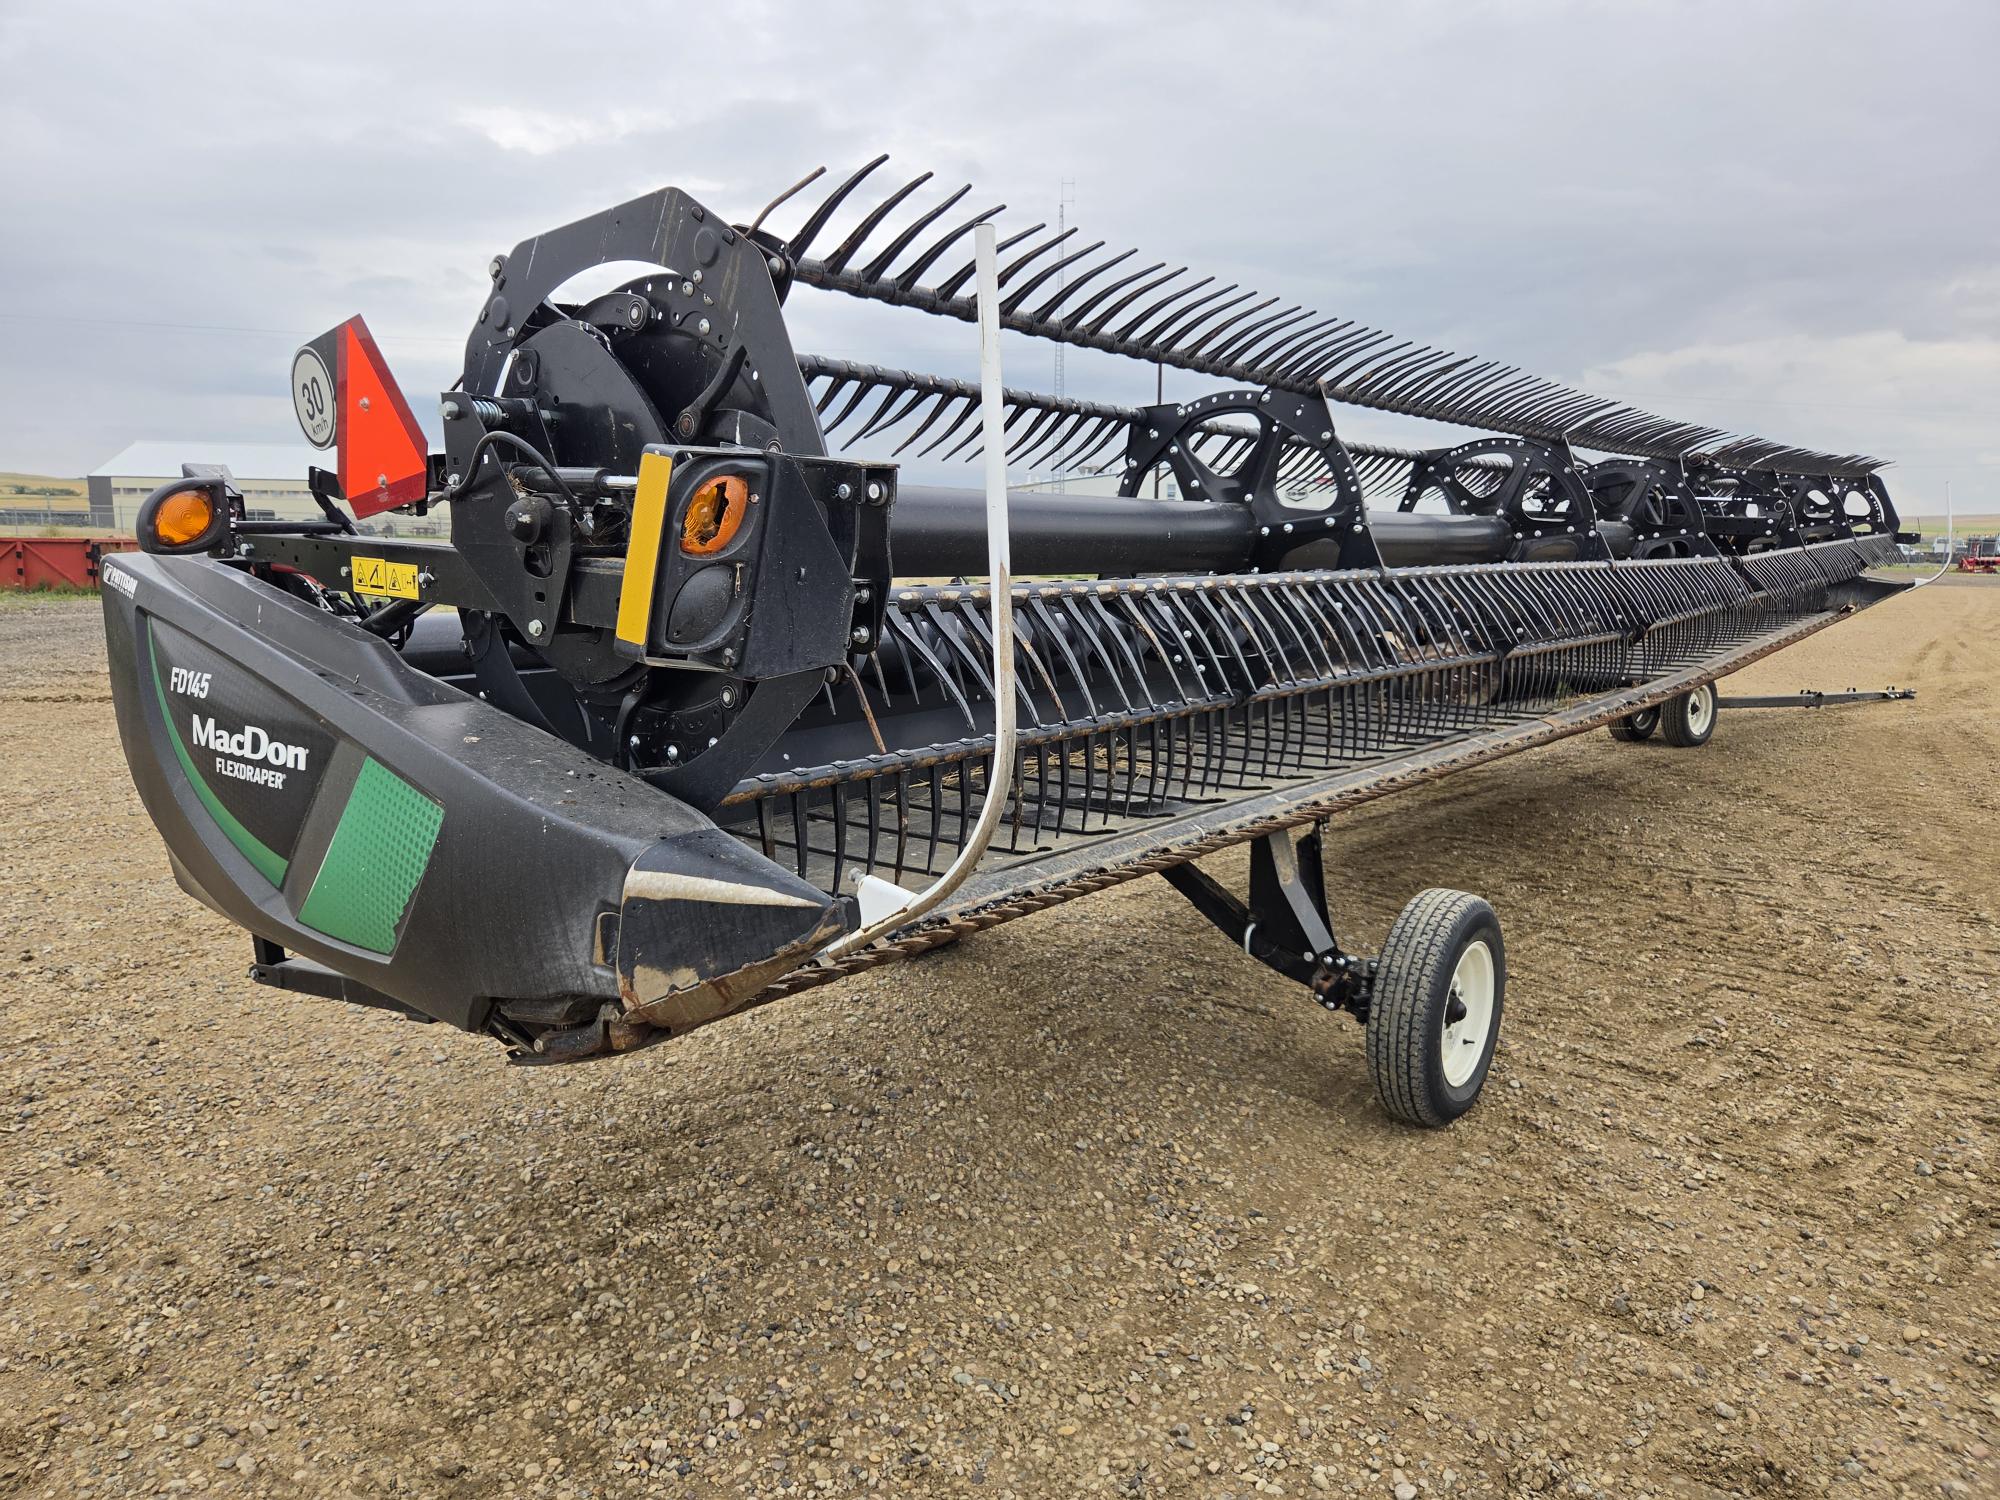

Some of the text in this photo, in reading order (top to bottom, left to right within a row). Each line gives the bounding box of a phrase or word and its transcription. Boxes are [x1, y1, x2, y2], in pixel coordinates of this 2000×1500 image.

[302, 376, 324, 421] 30
[311, 417, 329, 436] km/h
[170, 666, 212, 699] FD145
[192, 713, 307, 771] MacDon
[215, 757, 284, 790] FLEXDRAPER
